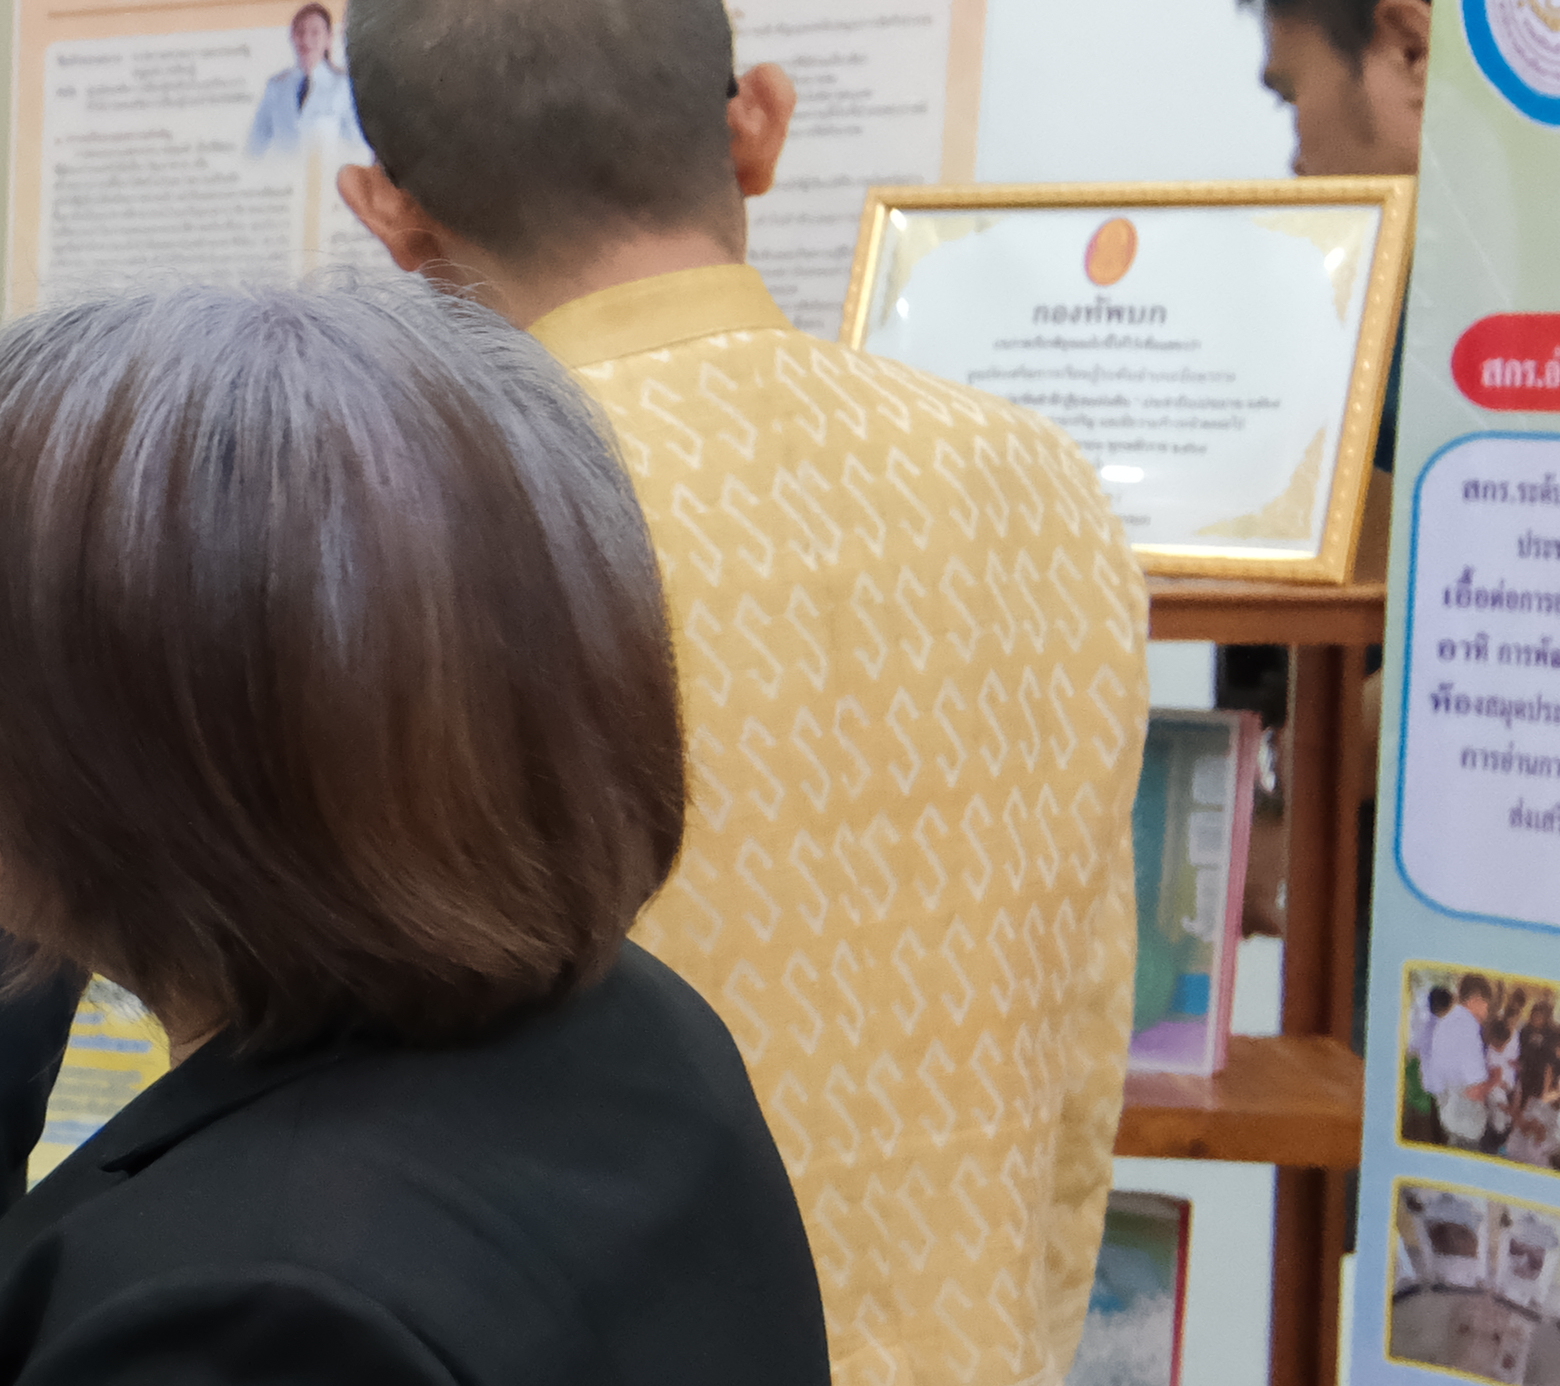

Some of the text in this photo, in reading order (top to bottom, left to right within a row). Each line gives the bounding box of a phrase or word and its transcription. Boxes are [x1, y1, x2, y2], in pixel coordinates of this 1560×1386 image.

[1032, 295, 1168, 325] กองทัพบก
[1481, 345, 1560, 389] สกร.อ
